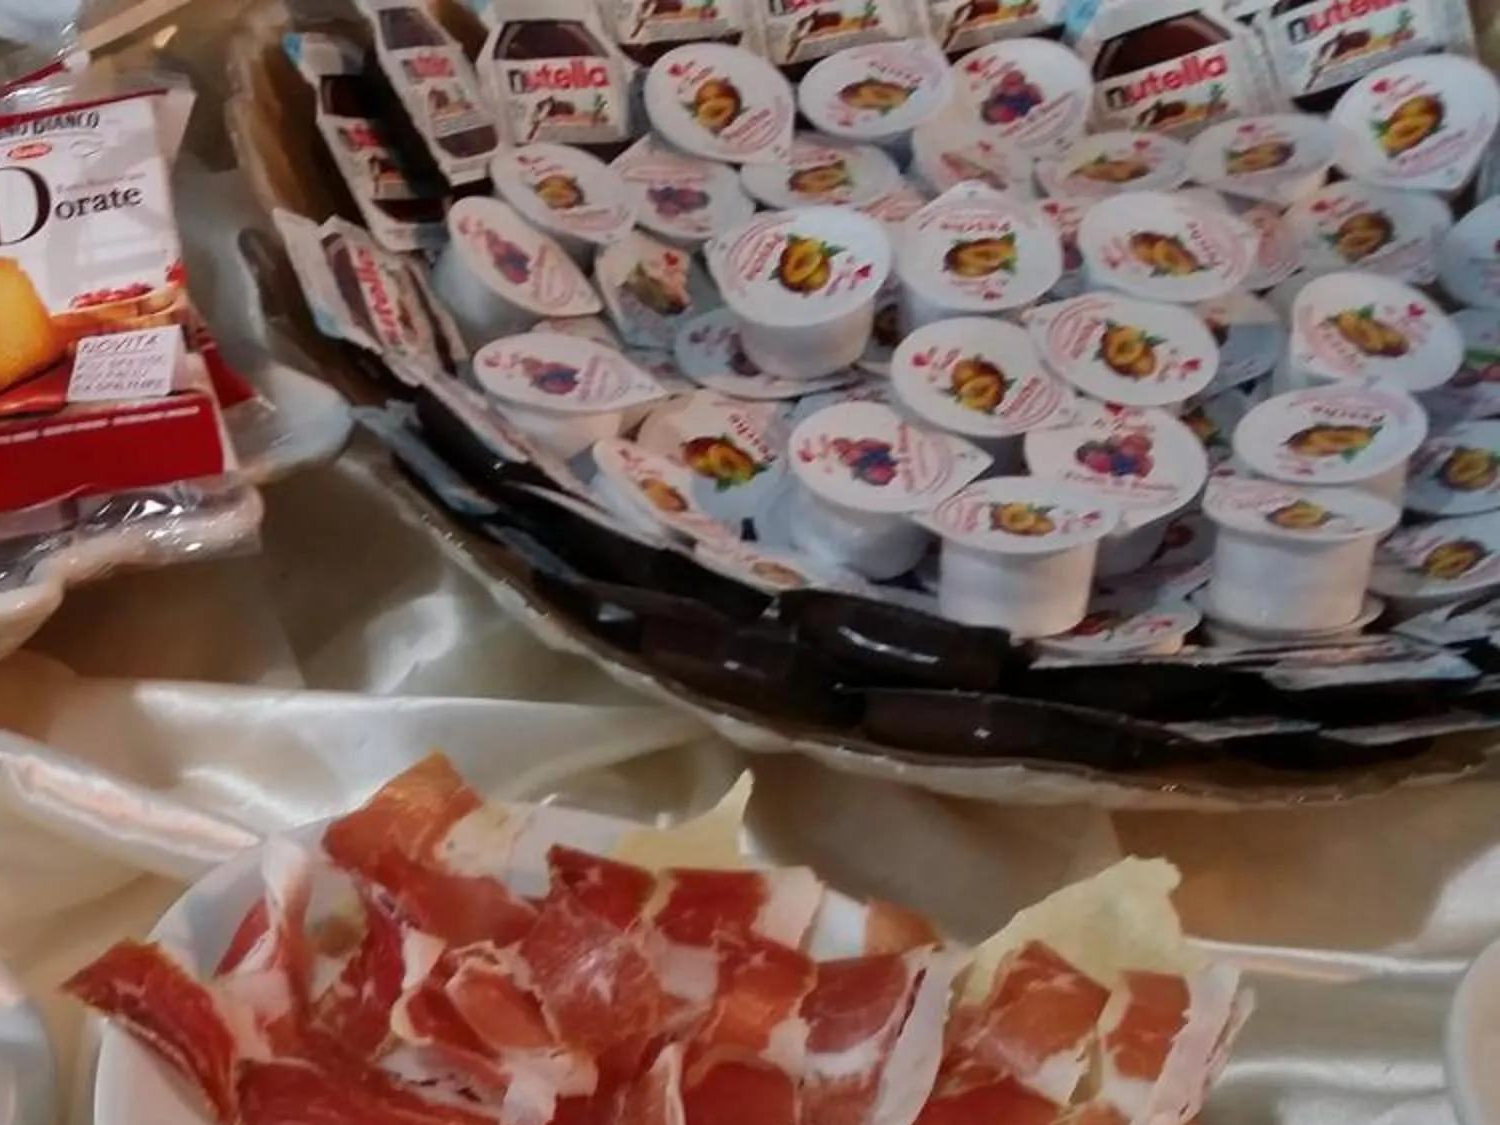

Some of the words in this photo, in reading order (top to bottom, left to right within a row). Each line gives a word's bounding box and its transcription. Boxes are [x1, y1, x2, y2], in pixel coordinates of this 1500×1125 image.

[1287, 0, 1406, 45] nute
[507, 60, 610, 94] nutella
[1106, 55, 1228, 107] nutella
